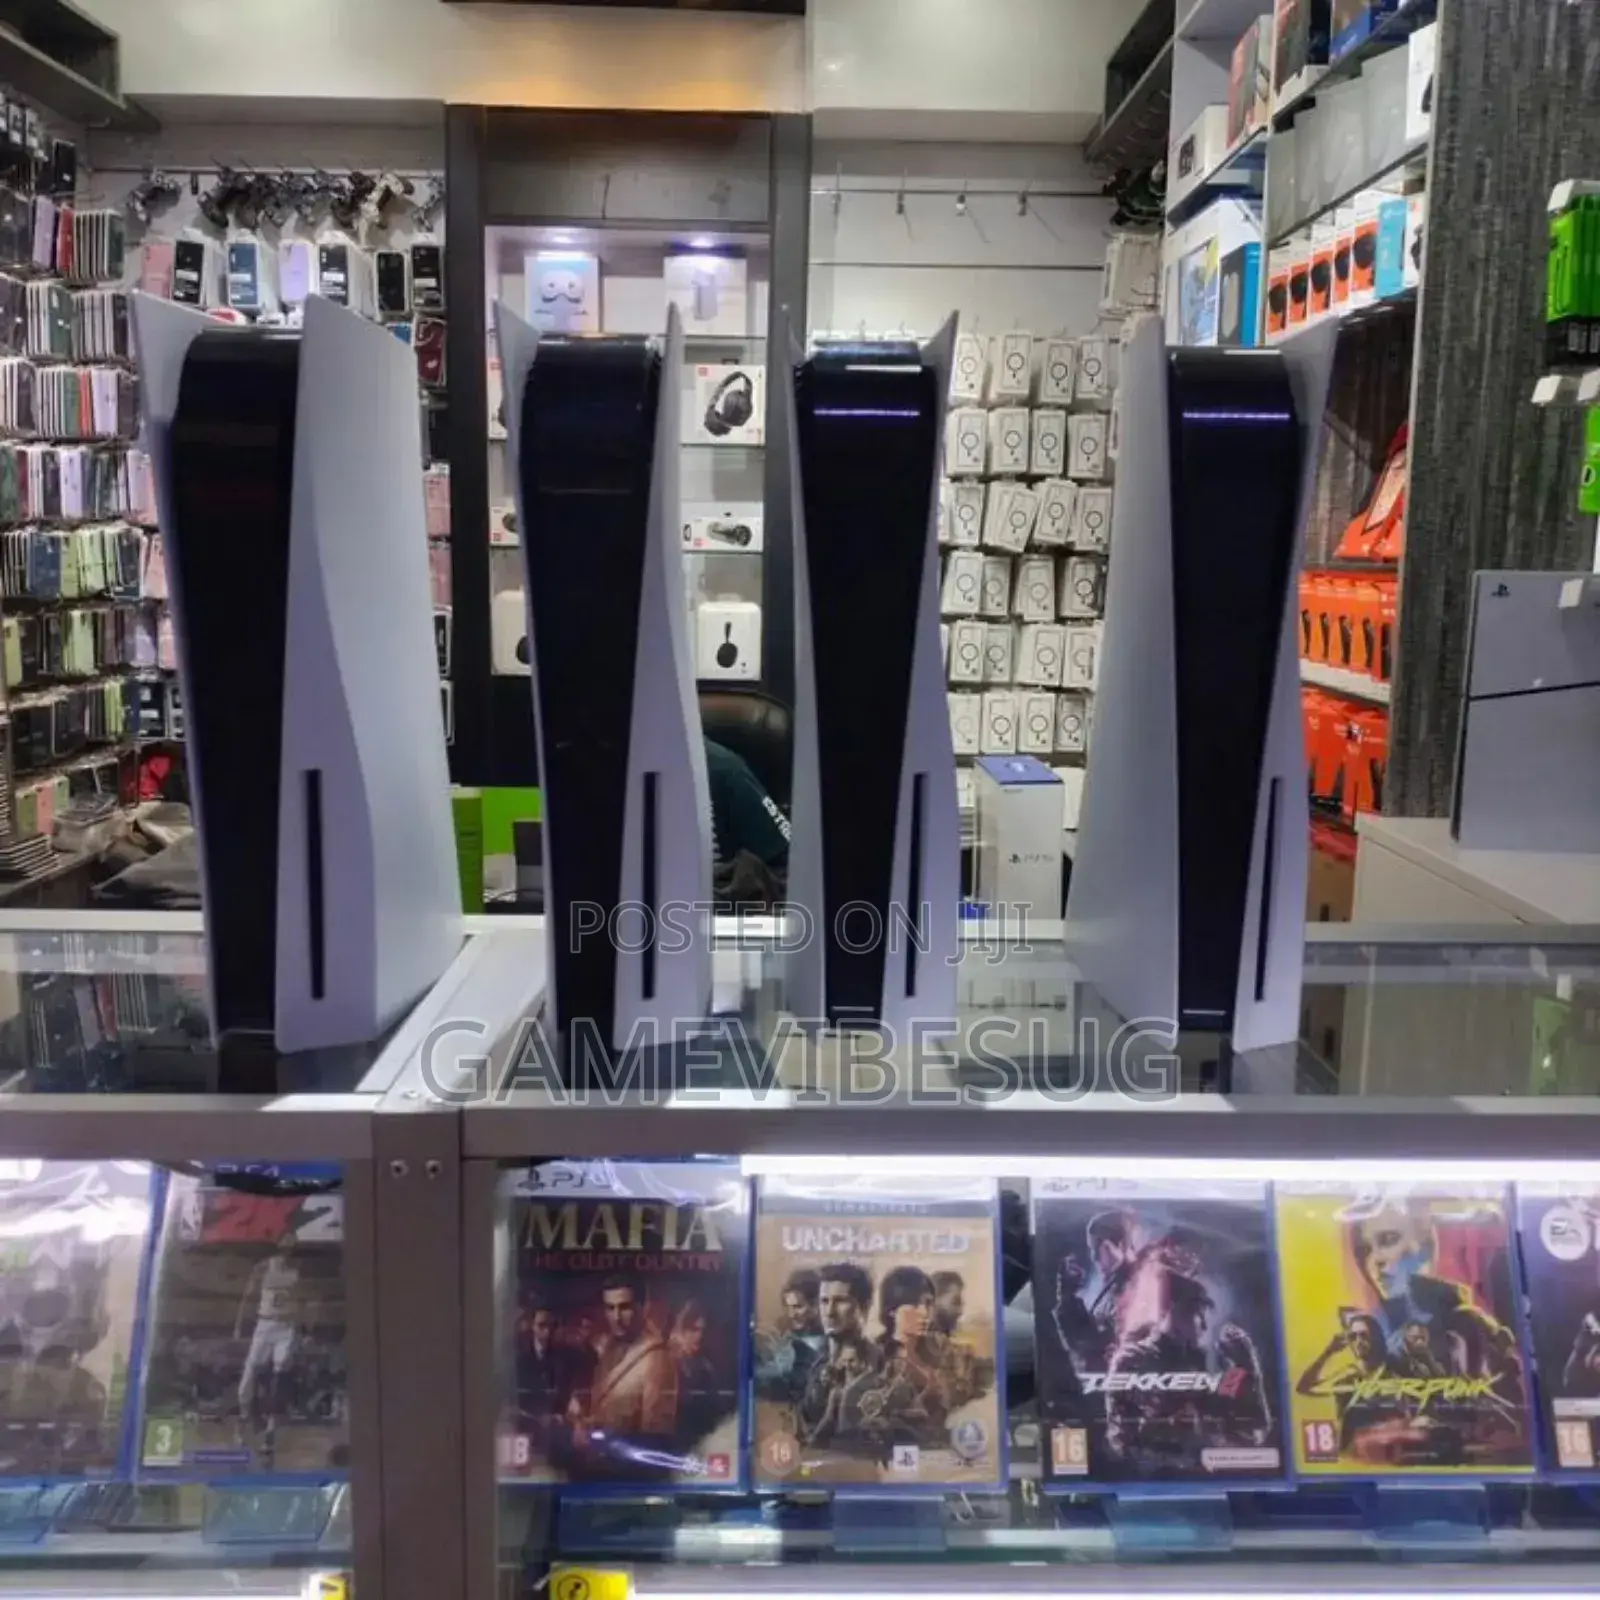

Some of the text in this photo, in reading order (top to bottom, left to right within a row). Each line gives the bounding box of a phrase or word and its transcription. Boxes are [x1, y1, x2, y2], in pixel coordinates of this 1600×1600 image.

[523, 1202, 723, 1251] MAFIA
[781, 1226, 972, 1254] UNCHARTED
[1076, 1372, 1222, 1395] TEKKEN
[156, 1426, 173, 1454] 3
[1054, 1432, 1086, 1462] 16
[1304, 1422, 1334, 1452] 18
